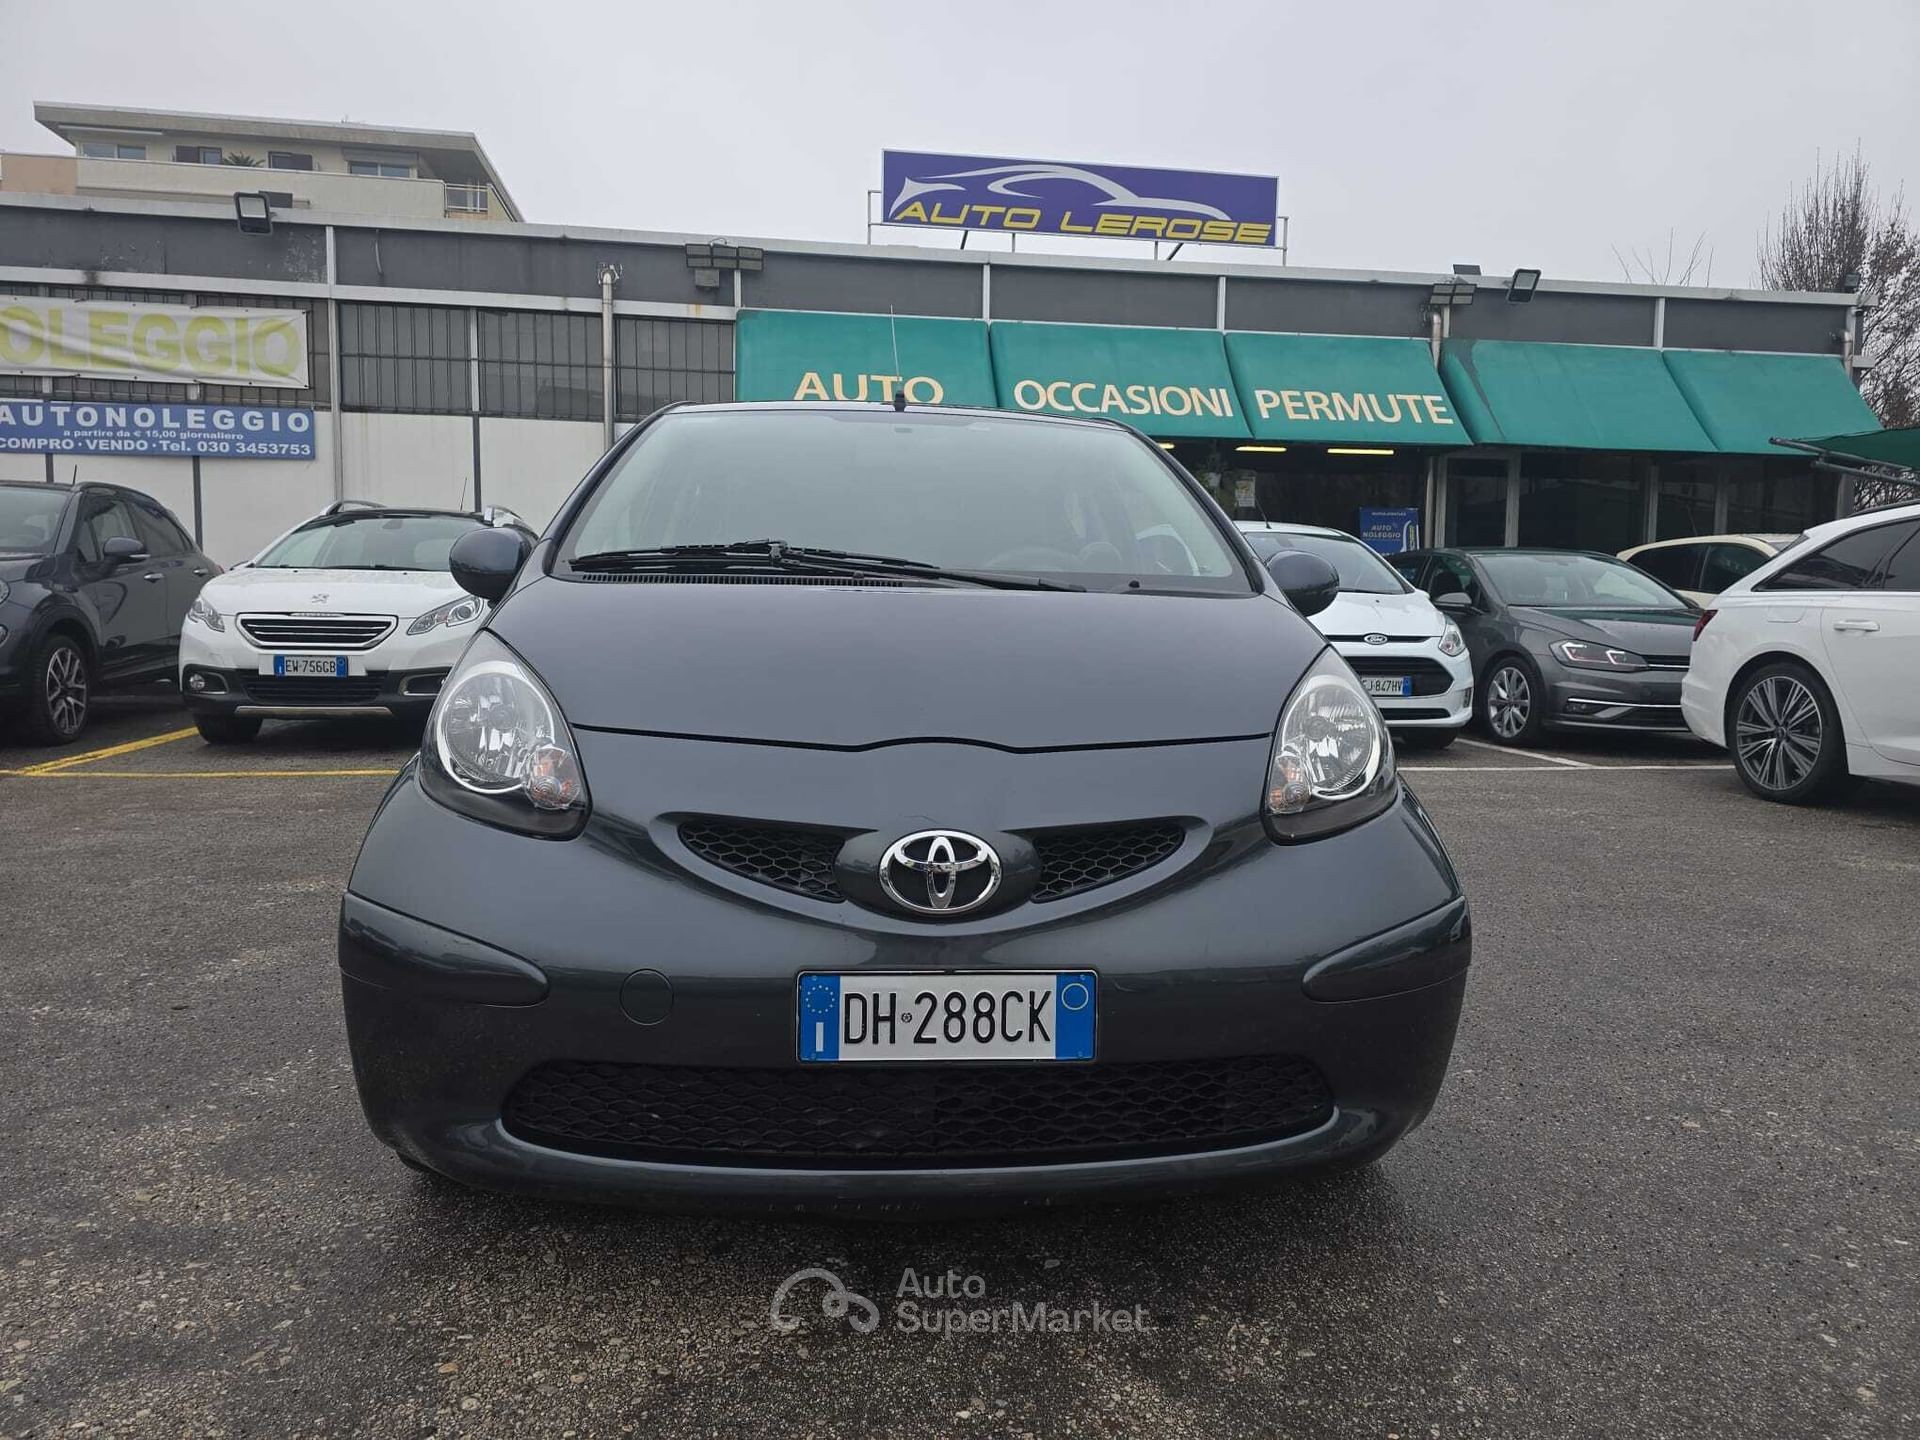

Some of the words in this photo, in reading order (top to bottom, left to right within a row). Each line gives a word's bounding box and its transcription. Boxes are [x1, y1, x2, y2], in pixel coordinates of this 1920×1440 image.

[894, 201, 1042, 231] AUTO
[1060, 211, 1272, 244] LEROSE
[0, 306, 299, 377] OLEGGIO
[793, 371, 944, 405] AUTO
[1013, 379, 1234, 418] OCCASIONI
[1254, 388, 1455, 425] PERMUTE
[0, 404, 310, 433] AUTONOLEGGIO
[74, 429, 113, 439] partire
[116, 430, 131, 438] da
[147, 430, 177, 439] 15,00
[180, 430, 244, 441] giornaliero
[86, 439, 148, 451] VENDO
[160, 440, 191, 452] Tel.
[197, 441, 230, 453] 030
[236, 442, 311, 456] 3453753
